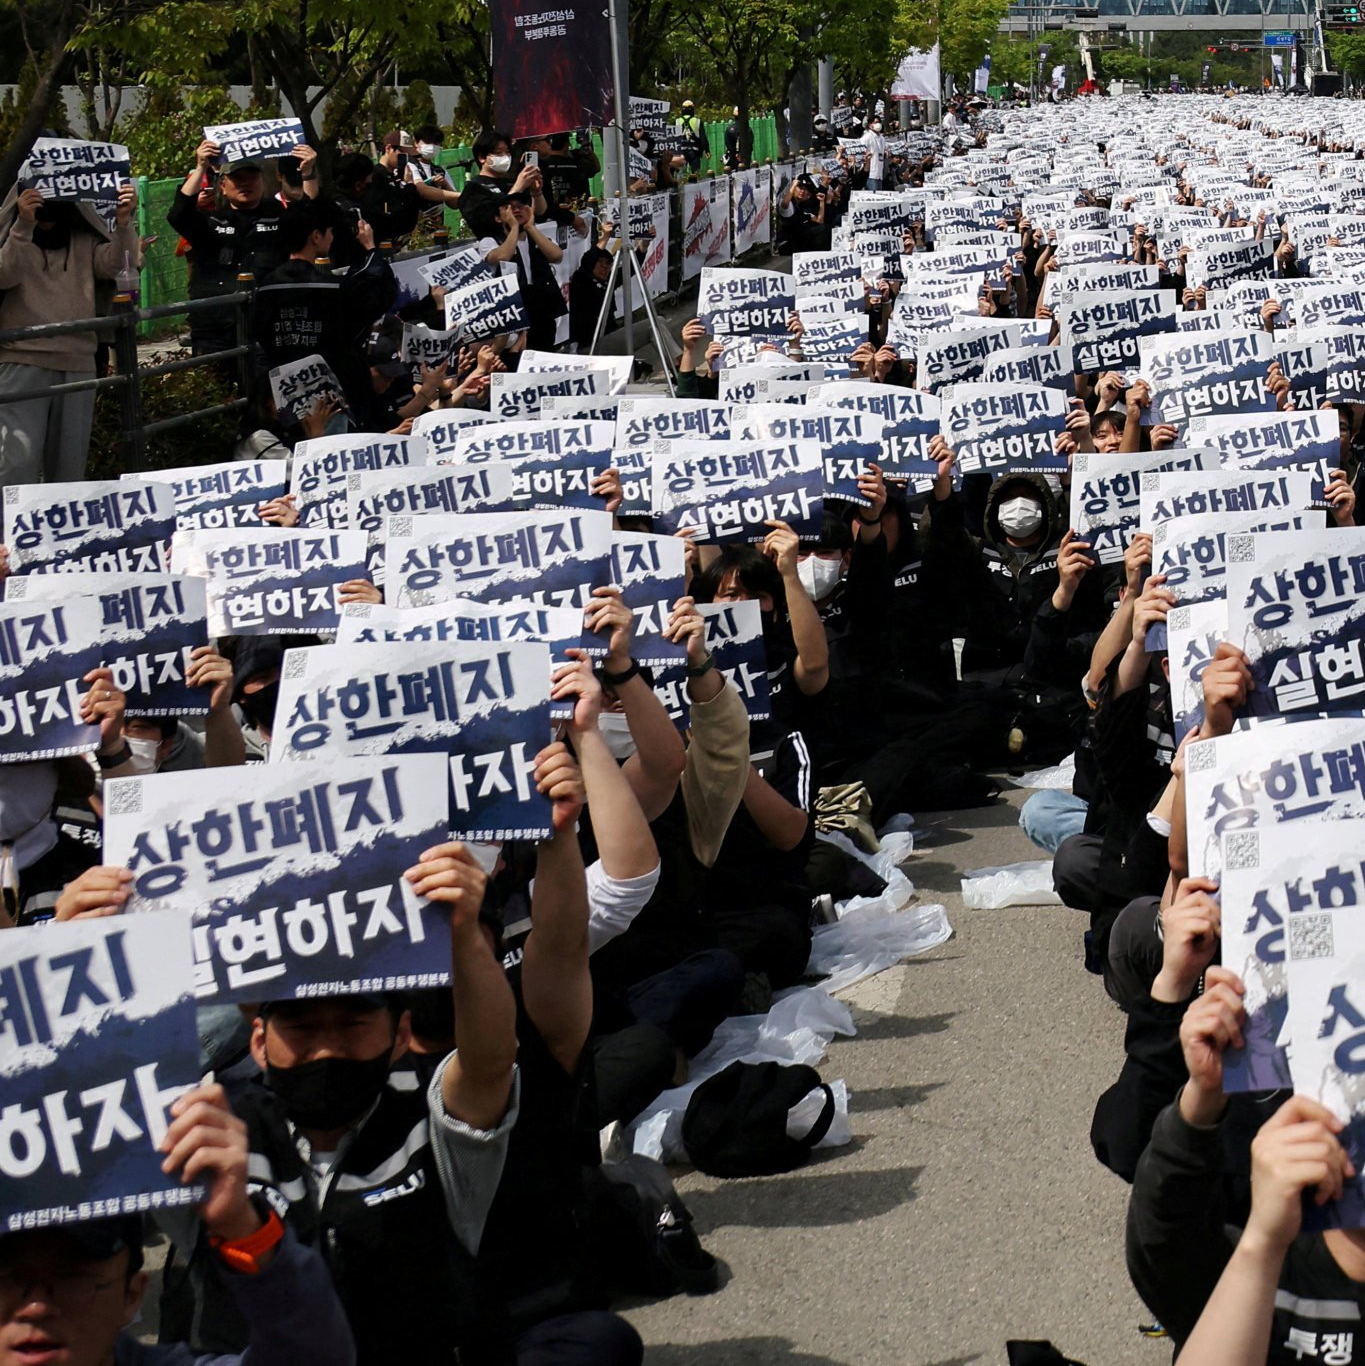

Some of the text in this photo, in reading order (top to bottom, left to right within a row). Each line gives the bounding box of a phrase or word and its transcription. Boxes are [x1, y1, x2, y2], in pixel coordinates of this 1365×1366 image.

[28, 145, 116, 169] 상한폐지
[224, 130, 299, 162] 실현하자
[34, 171, 125, 199] 실현하자
[449, 279, 508, 320] 상한폐지
[705, 276, 787, 302] 상한폐지
[710, 306, 793, 336] 실현하자
[462, 424, 593, 462] 상한폐지
[298, 440, 409, 491] 상한폐지
[12, 486, 159, 549] 상한폐지
[402, 517, 585, 590] 상한폐지
[290, 651, 517, 751] 상한폐지
[130, 766, 407, 899] 상한폐지
[296, 972, 450, 998] 삼성전자노동조합 공동투쟁본부
[364, 1169, 425, 1208] SELU
[9, 1187, 205, 1230] 삼성전자노동조합 공동투쟁본부
[1284, 1331, 1353, 1366] 투쟁
